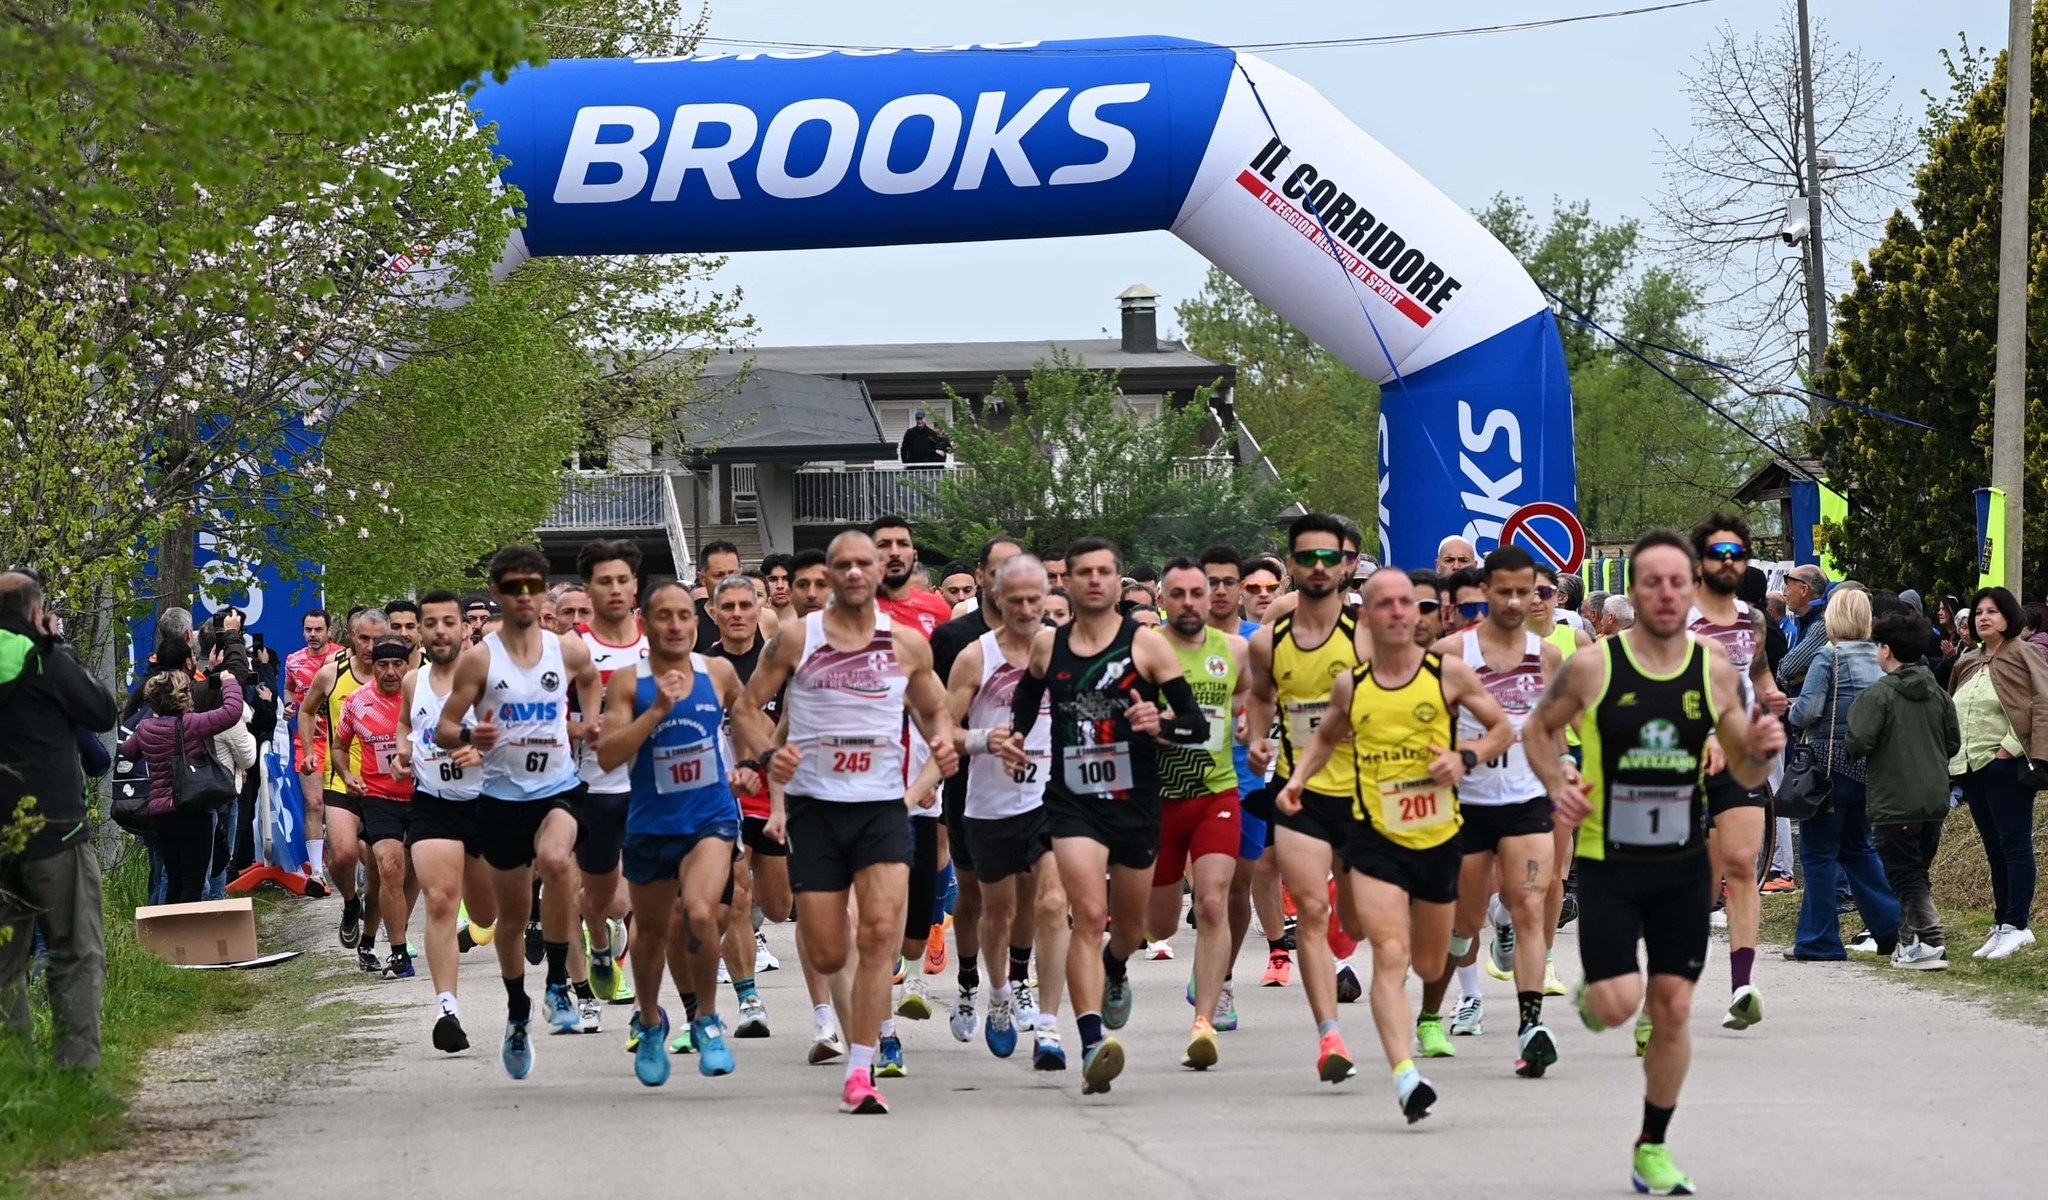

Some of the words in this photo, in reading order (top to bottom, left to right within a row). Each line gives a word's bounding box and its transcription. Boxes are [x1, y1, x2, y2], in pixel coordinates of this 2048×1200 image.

[553, 82, 1151, 204] BROOKS
[1249, 137, 1291, 183] IL
[1282, 163, 1462, 314] CORRIDORE
[1258, 188, 1274, 205] IL
[1268, 196, 1317, 238] PEGGIOR
[1311, 231, 1357, 271] NEGOZIO
[1353, 264, 1371, 281] DI
[1366, 276, 1404, 306] SPORT
[1208, 682, 1228, 691] TEAM
[499, 702, 557, 722] AVIS
[439, 762, 463, 782] 66
[525, 752, 549, 773] 67
[668, 758, 702, 784] 167
[832, 752, 871, 773] 245
[1078, 760, 1116, 784] 100
[1398, 792, 1437, 821] 201
[1647, 807, 1660, 834] 1
